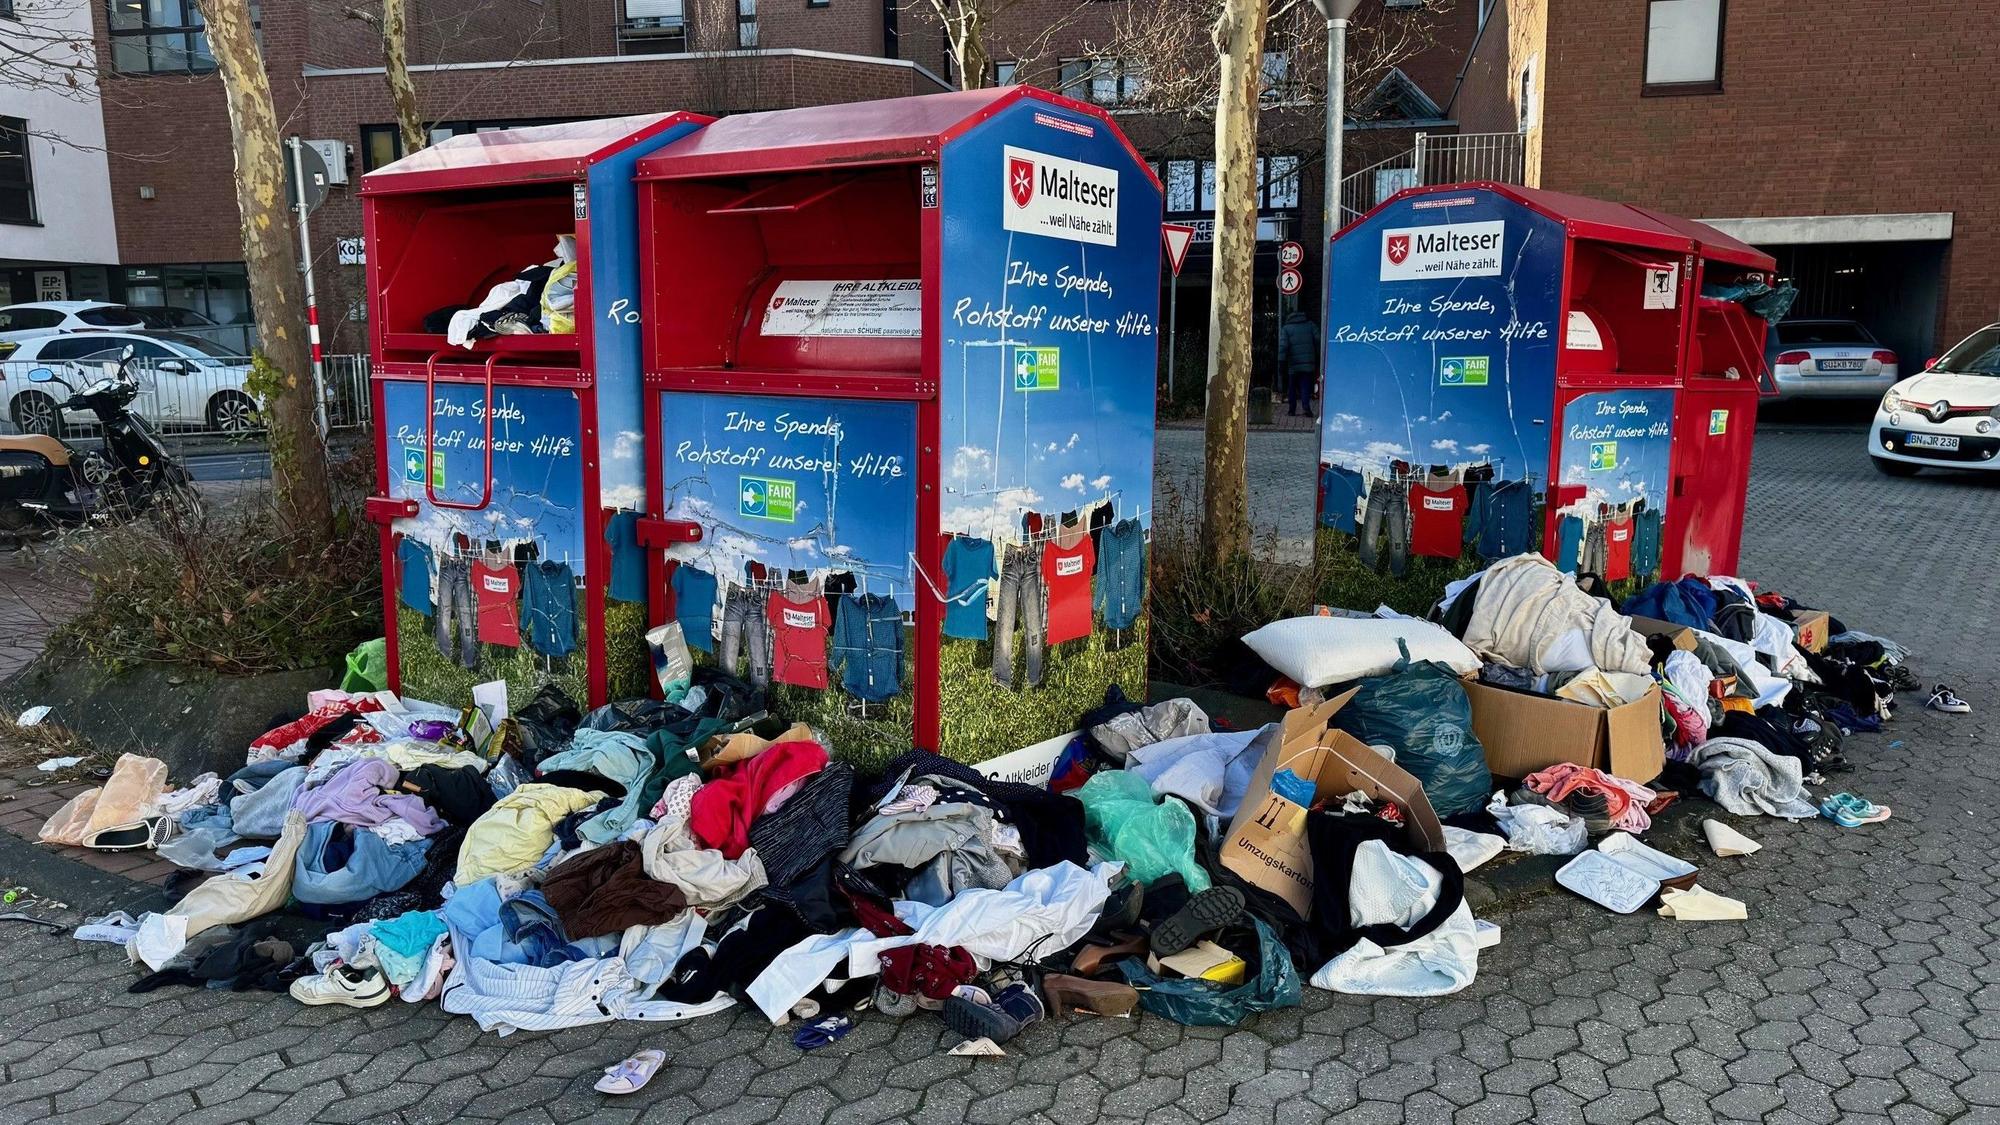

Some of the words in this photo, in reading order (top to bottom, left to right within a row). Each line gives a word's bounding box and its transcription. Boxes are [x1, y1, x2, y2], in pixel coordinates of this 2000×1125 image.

[1041, 165, 1115, 208] Malteser
[1069, 214, 1091, 232] Nähe
[1092, 219, 1115, 236] zählt.
[338, 242, 365, 256] Kos
[1416, 230, 1501, 254] Malteser
[1445, 259, 1471, 272] Nähe
[1472, 257, 1499, 270] zählt.
[42, 276, 61, 287] EP:
[832, 282, 862, 292] IHRE
[861, 281, 922, 292] ALTKLEIDE
[1007, 261, 1049, 288] Ihre
[1055, 265, 1113, 299] Spende,
[42, 291, 62, 301] IKS
[784, 297, 820, 307] Malteser
[1382, 297, 1422, 315] Ihre
[1429, 294, 1496, 318] Spende,
[953, 296, 1047, 329] Rohstoff
[1050, 313, 1110, 334] unserer
[1116, 311, 1151, 338] Hilfe
[1335, 324, 1420, 343] Rohstoff
[1422, 326, 1491, 341] unserer
[1499, 320, 1549, 342] Hilfe
[1039, 353, 1057, 367] FAIR
[1465, 359, 1486, 370] FAIR
[433, 398, 465, 418] Ihre
[1595, 400, 1616, 416] Ihre
[1619, 399, 1649, 419] Spende,
[723, 411, 766, 433] Ihre
[773, 412, 845, 441] Spende,
[1568, 424, 1614, 441] Rohstoff
[1614, 427, 1645, 438] unserer
[1648, 421, 1669, 439] Hilfe
[530, 434, 572, 458] Hilfe
[1910, 434, 1923, 444] BN
[1927, 435, 1939, 446] JR
[1940, 436, 1958, 448] 238
[675, 440, 766, 467] Rohstoff
[768, 454, 841, 474] unserer
[851, 453, 903, 478] Hilfe
[767, 484, 792, 498] FAIR
[1005, 762, 1051, 784] Altkleider
[1238, 836, 1314, 891] Umzugskarton
